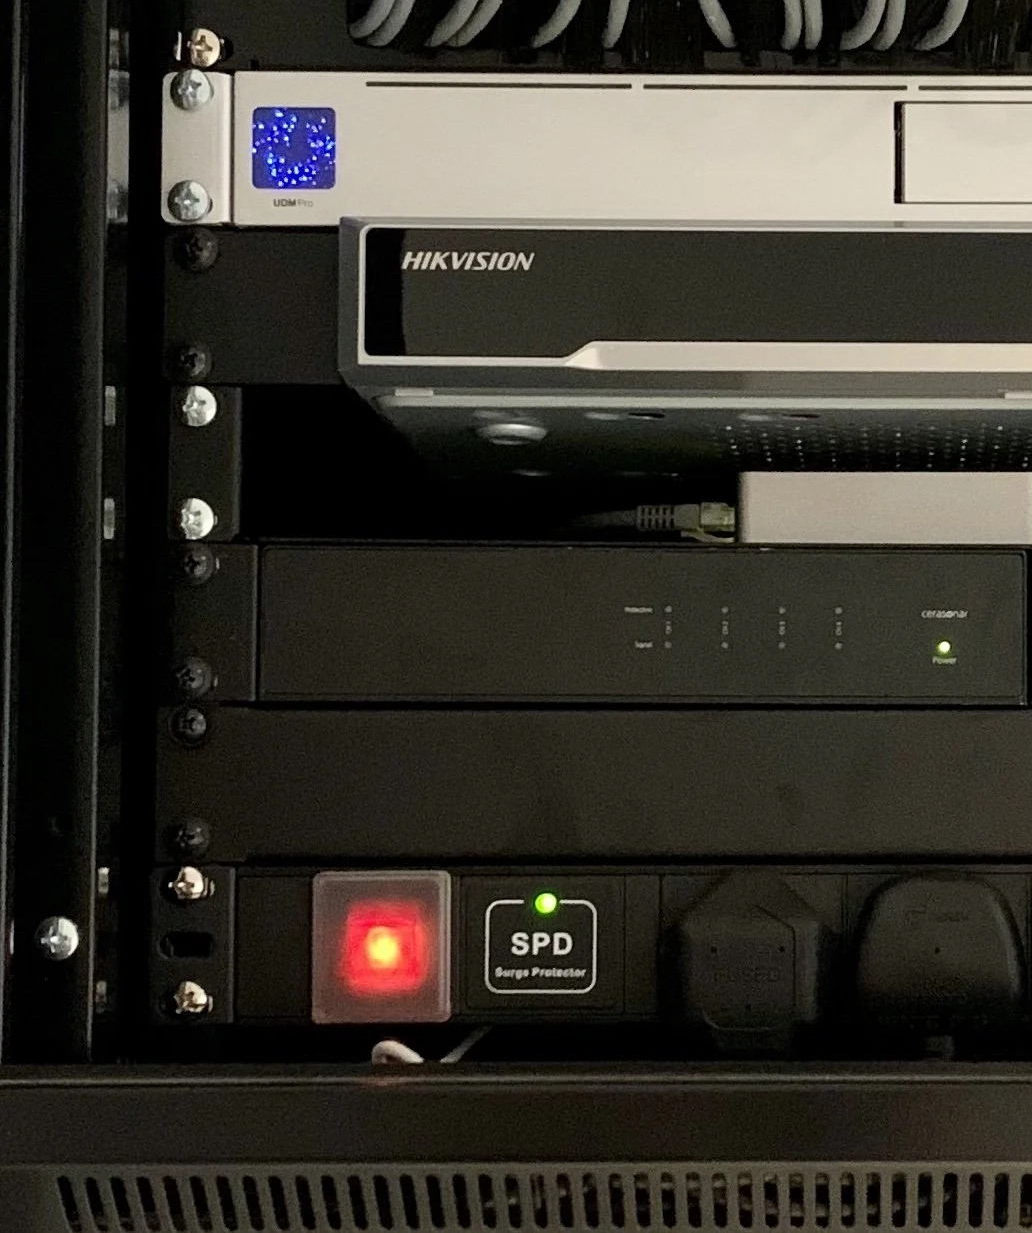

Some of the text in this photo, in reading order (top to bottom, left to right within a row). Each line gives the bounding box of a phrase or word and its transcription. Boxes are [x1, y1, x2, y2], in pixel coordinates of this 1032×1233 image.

[273, 198, 314, 208] UDM Pro
[401, 251, 535, 271] HIKVISION
[921, 609, 969, 619] cerasonar
[511, 931, 574, 956] SPD
[495, 966, 587, 980] Surge Protector
